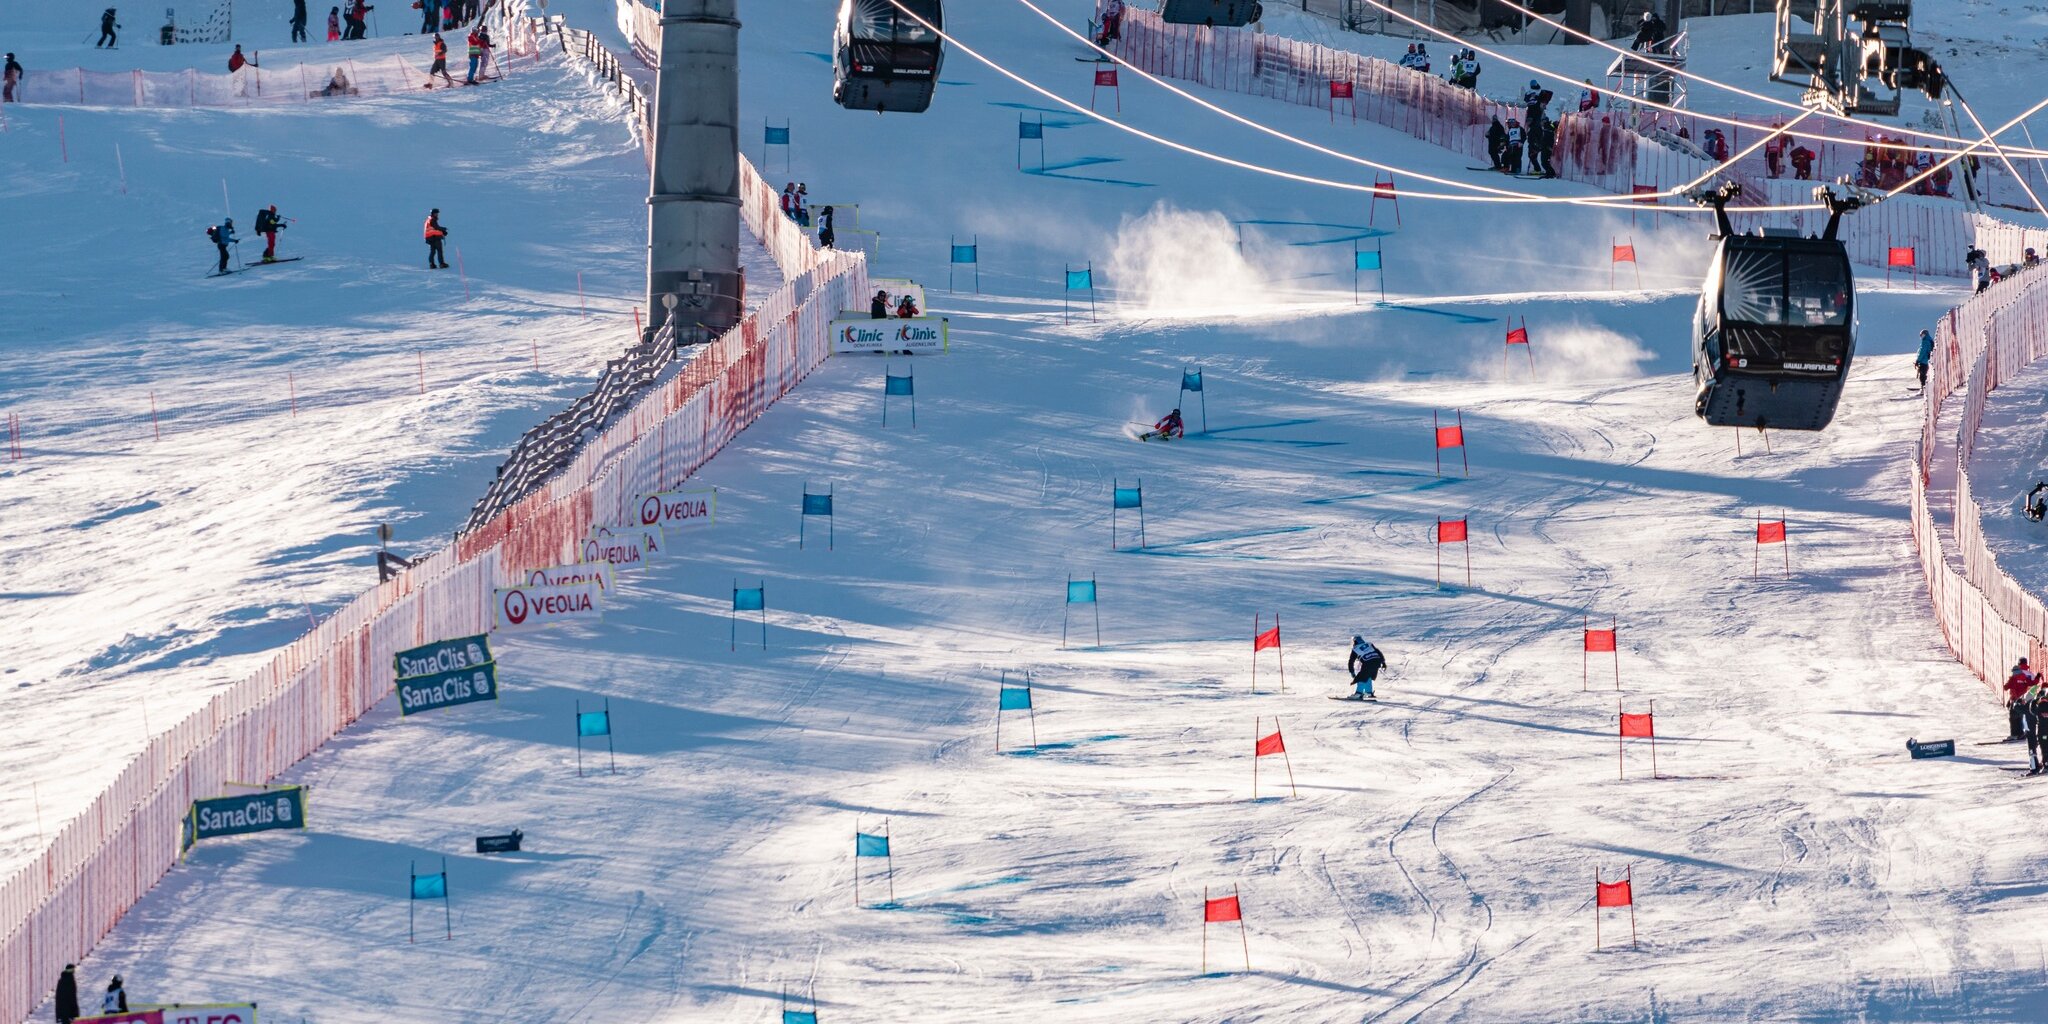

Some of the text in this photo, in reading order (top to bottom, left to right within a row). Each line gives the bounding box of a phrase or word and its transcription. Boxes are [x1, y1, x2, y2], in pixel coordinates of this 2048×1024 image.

[840, 325, 884, 343] iClinic
[895, 324, 937, 341] iClinic
[1738, 359, 1748, 368] 9
[664, 500, 707, 520] VEOLIA
[600, 544, 641, 564] VEOLIA
[530, 593, 593, 615] VEOLIA
[400, 647, 467, 677] SanaClis
[402, 677, 472, 707] SanaClis
[199, 800, 275, 830] SanaClis
